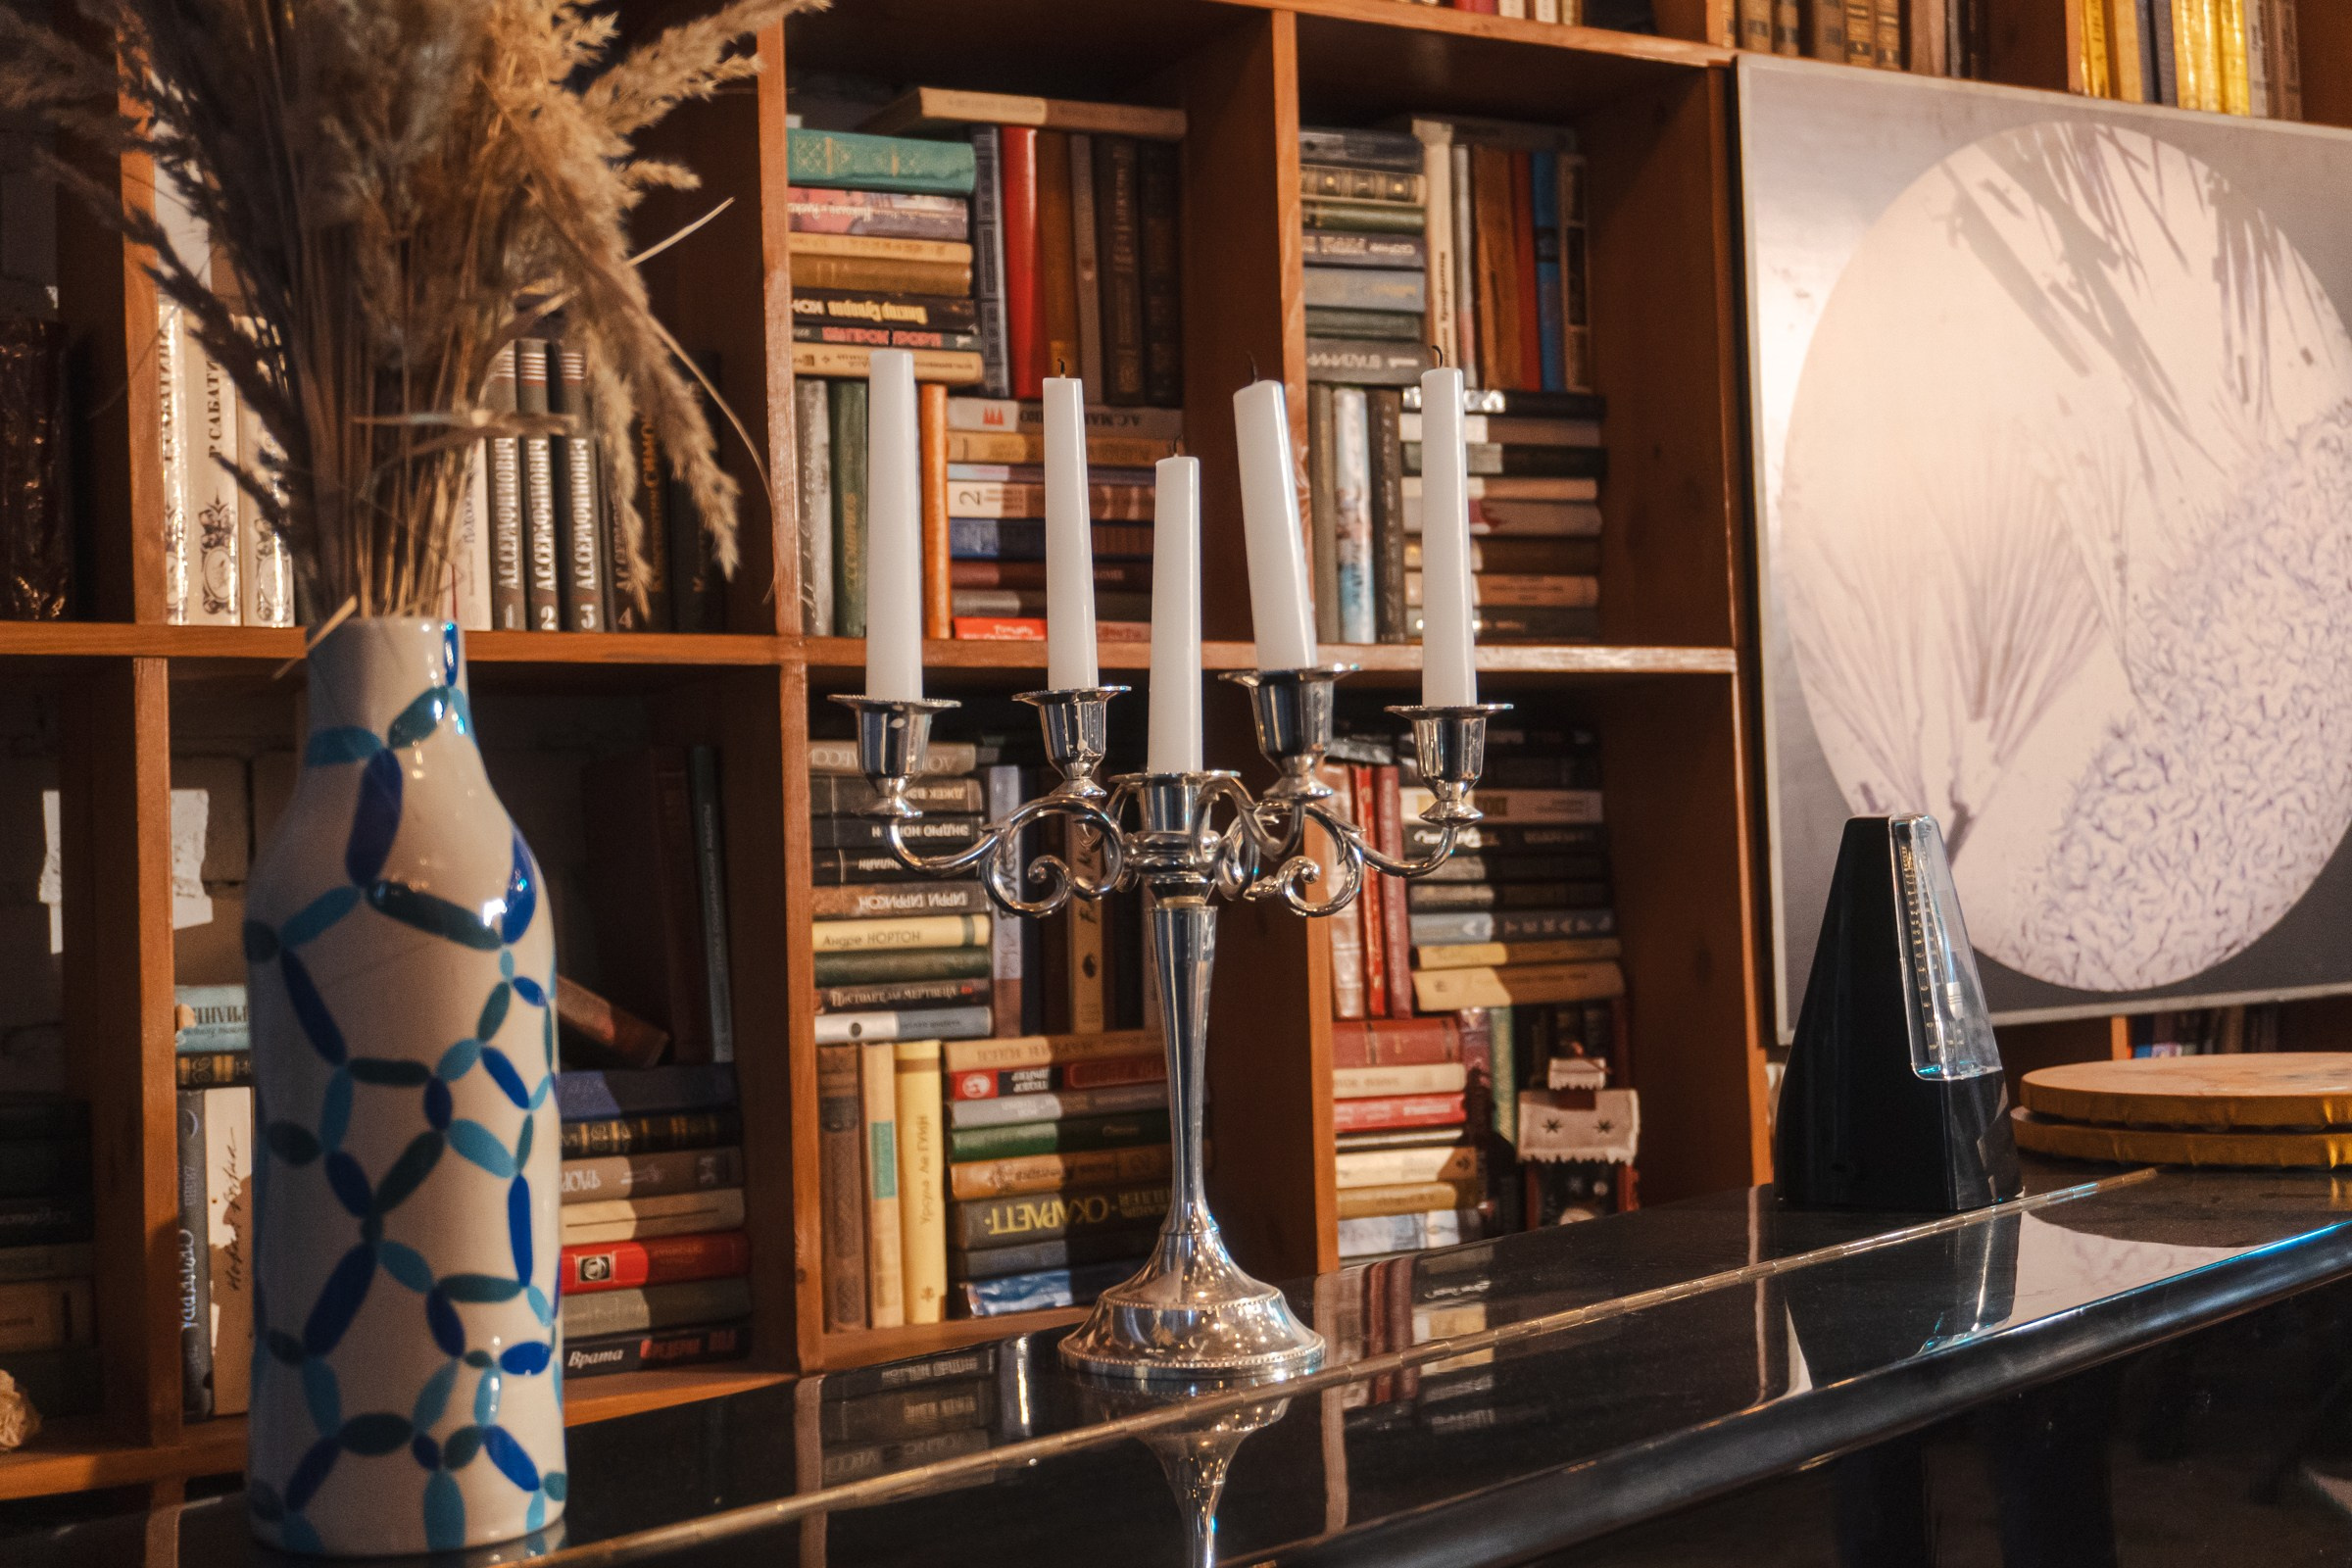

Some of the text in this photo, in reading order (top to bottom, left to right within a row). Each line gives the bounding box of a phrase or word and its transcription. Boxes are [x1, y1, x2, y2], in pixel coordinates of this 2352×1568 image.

[206, 361, 221, 441] САБАТИ
[505, 604, 514, 628] 1
[540, 605, 557, 630] 2
[580, 604, 596, 629] 3
[923, 823, 969, 838] ЭНДРЮ
[858, 892, 968, 910] ГАРРИ ГАРРИСОН
[822, 930, 920, 949] Андре НОРТОН
[916, 1116, 930, 1152] ГУИН
[989, 1195, 1108, 1235] СКАРЛЕТТ
[568, 1348, 623, 1368] Врата
